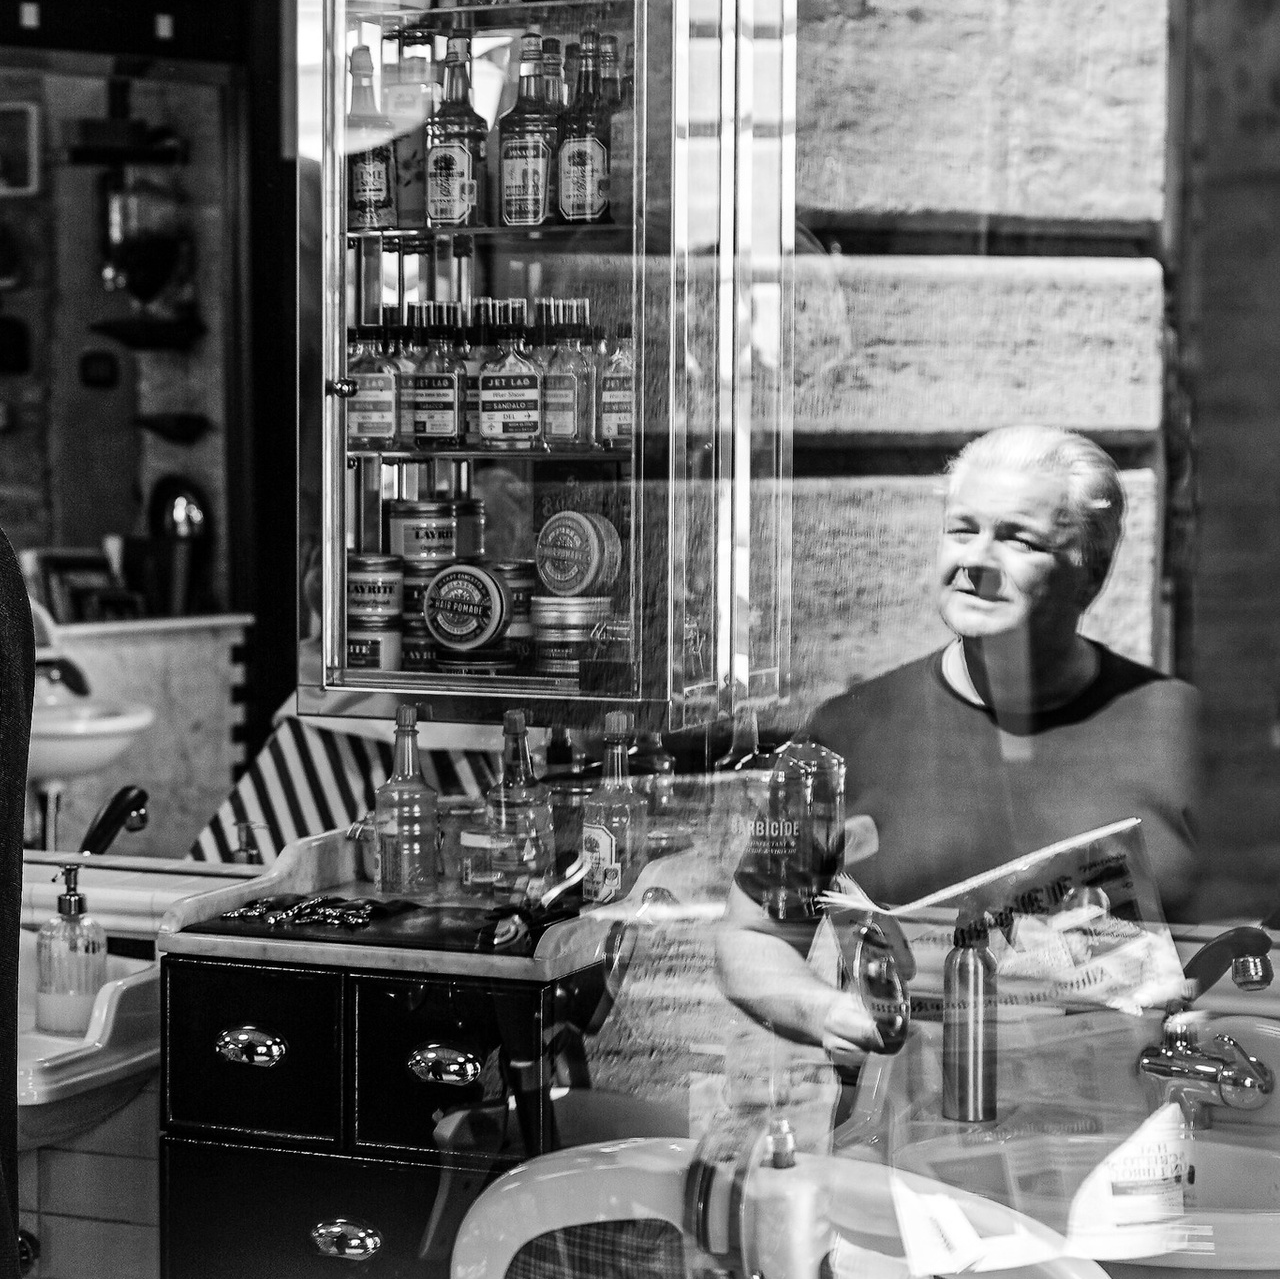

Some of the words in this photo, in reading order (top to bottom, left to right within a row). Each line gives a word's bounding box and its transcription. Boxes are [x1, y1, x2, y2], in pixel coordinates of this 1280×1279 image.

[488, 378, 507, 387] JET
[510, 377, 530, 387] LAG
[493, 402, 526, 410] SANDALO
[453, 602, 483, 615] POMADE
[731, 813, 800, 837] BARBICIDE
